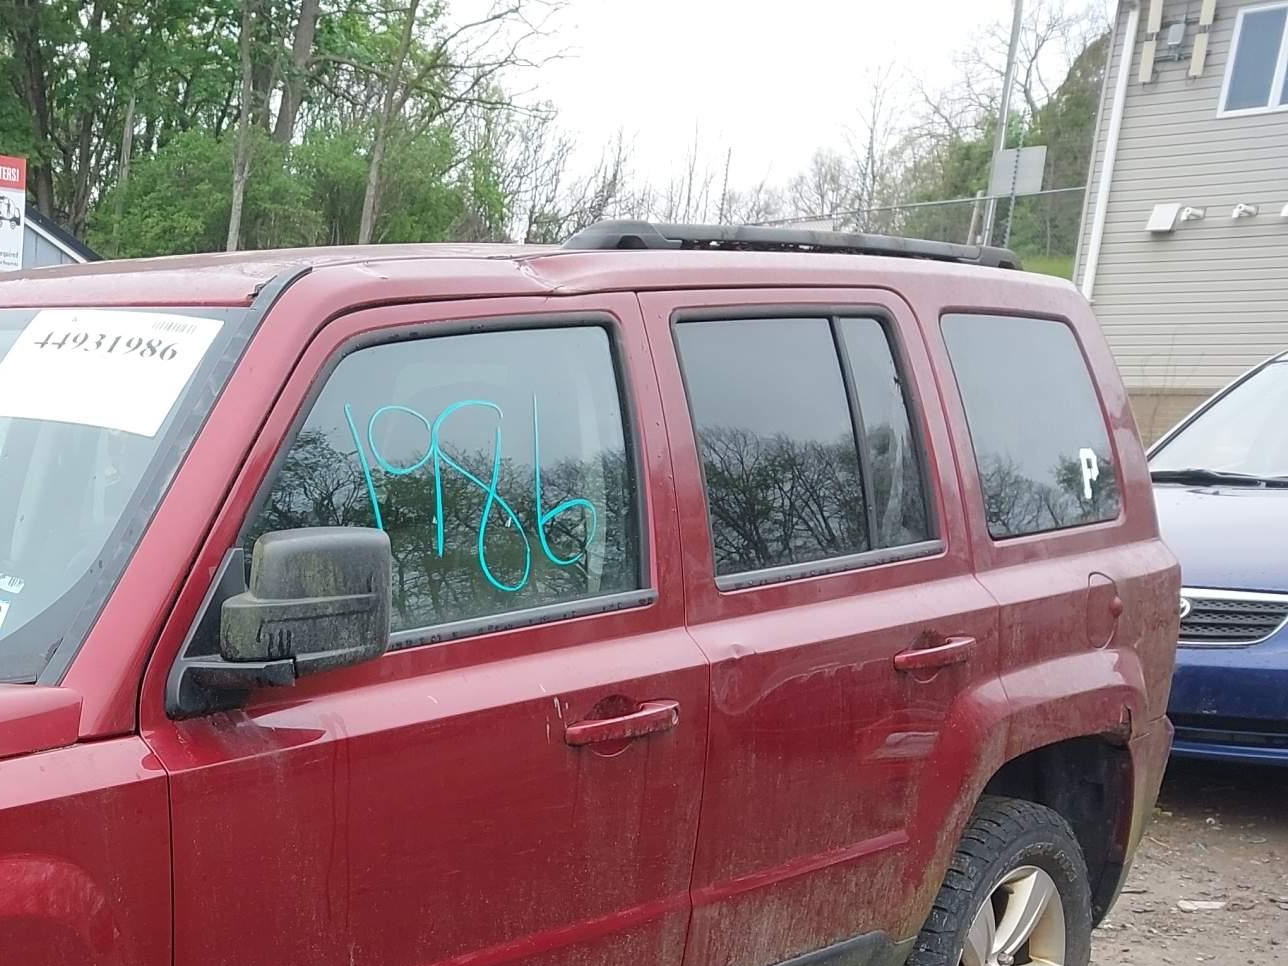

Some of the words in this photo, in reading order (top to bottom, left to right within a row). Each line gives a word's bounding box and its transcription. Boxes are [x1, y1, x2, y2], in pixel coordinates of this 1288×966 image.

[33, 330, 178, 361] 44931986
[344, 391, 597, 592] 1986
[1079, 447, 1099, 499] P
